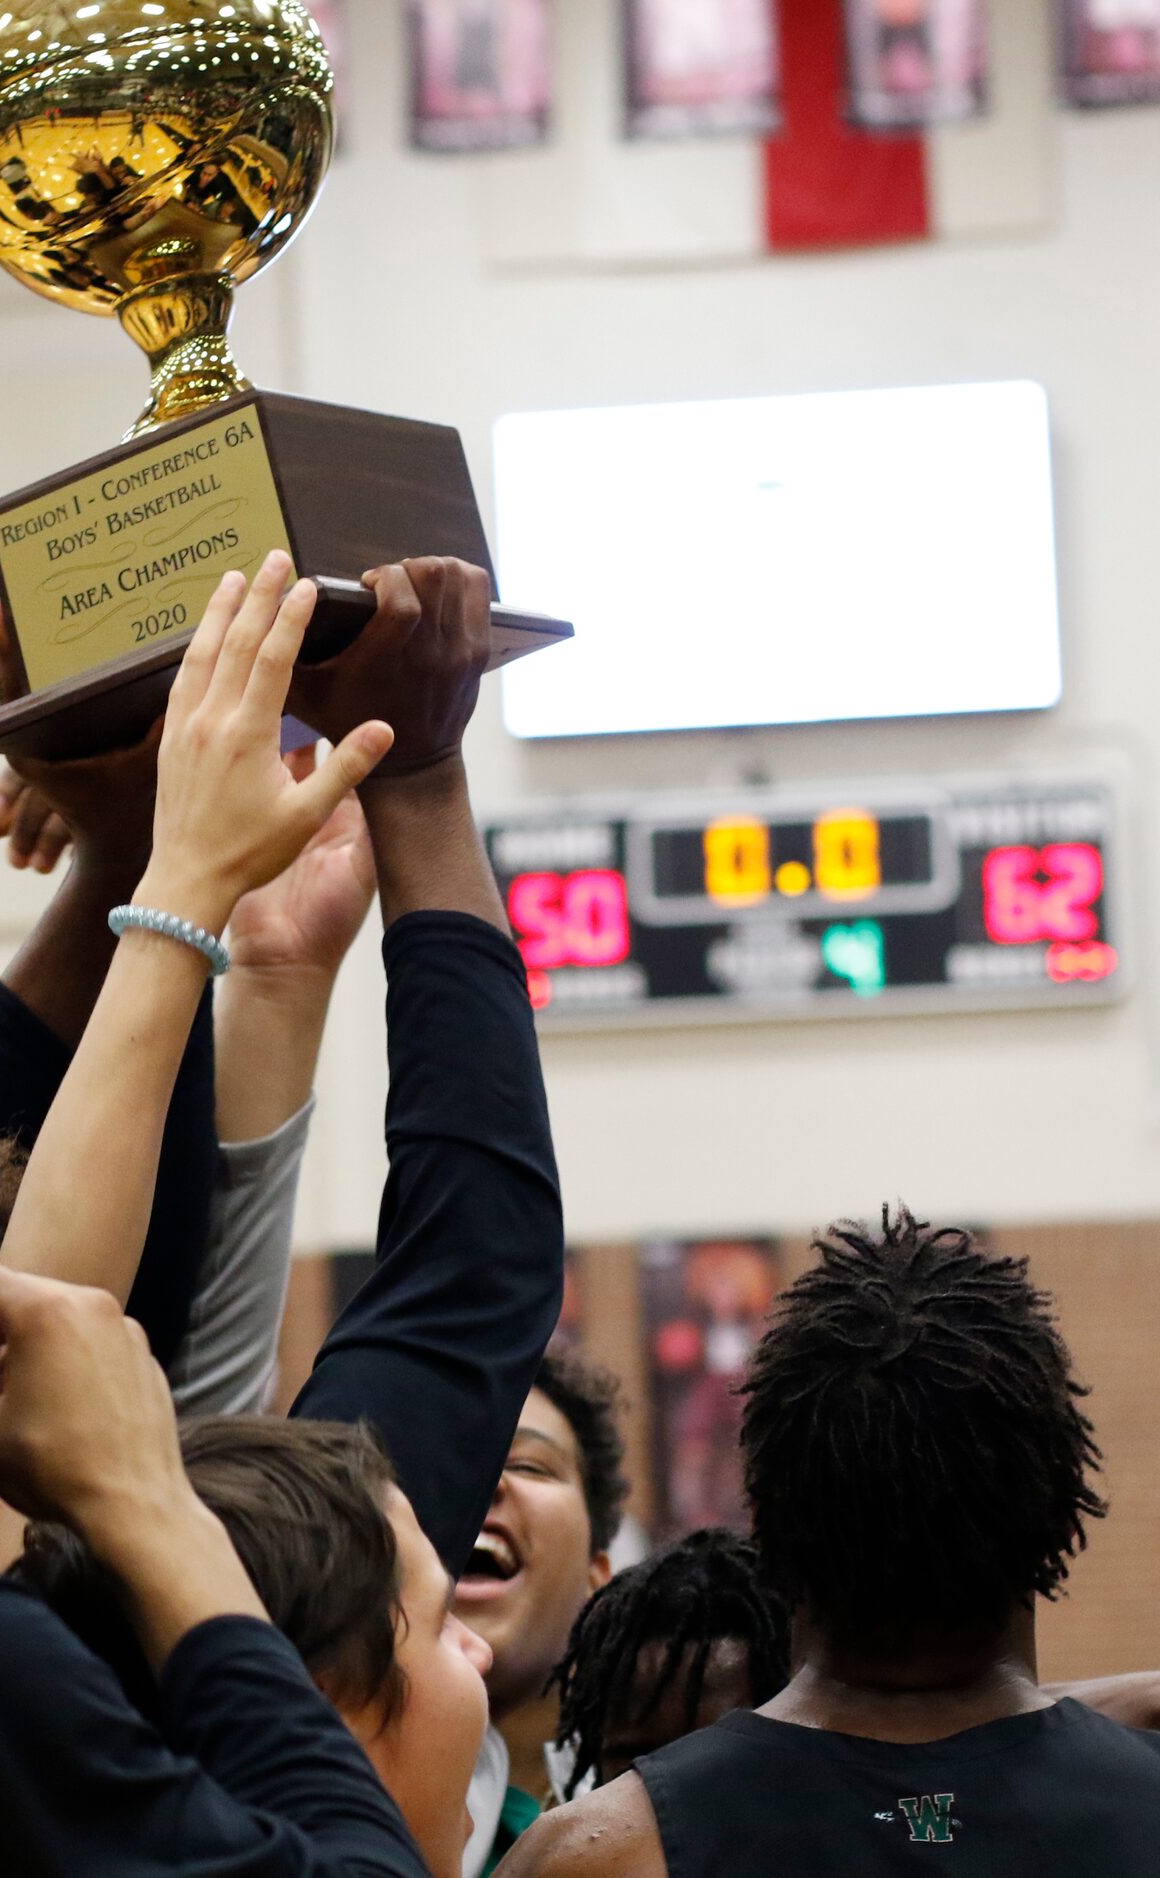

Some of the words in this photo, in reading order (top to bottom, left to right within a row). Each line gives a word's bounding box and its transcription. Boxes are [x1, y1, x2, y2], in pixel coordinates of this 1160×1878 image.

[225, 420, 255, 449] 6A
[107, 474, 222, 536] BASKETBALL
[59, 583, 113, 620] AREA
[117, 528, 240, 592] CHAMPIONS
[131, 603, 188, 643] 2020
[508, 869, 629, 969] 50
[983, 842, 1104, 944] 62
[898, 1793, 954, 1842] W
